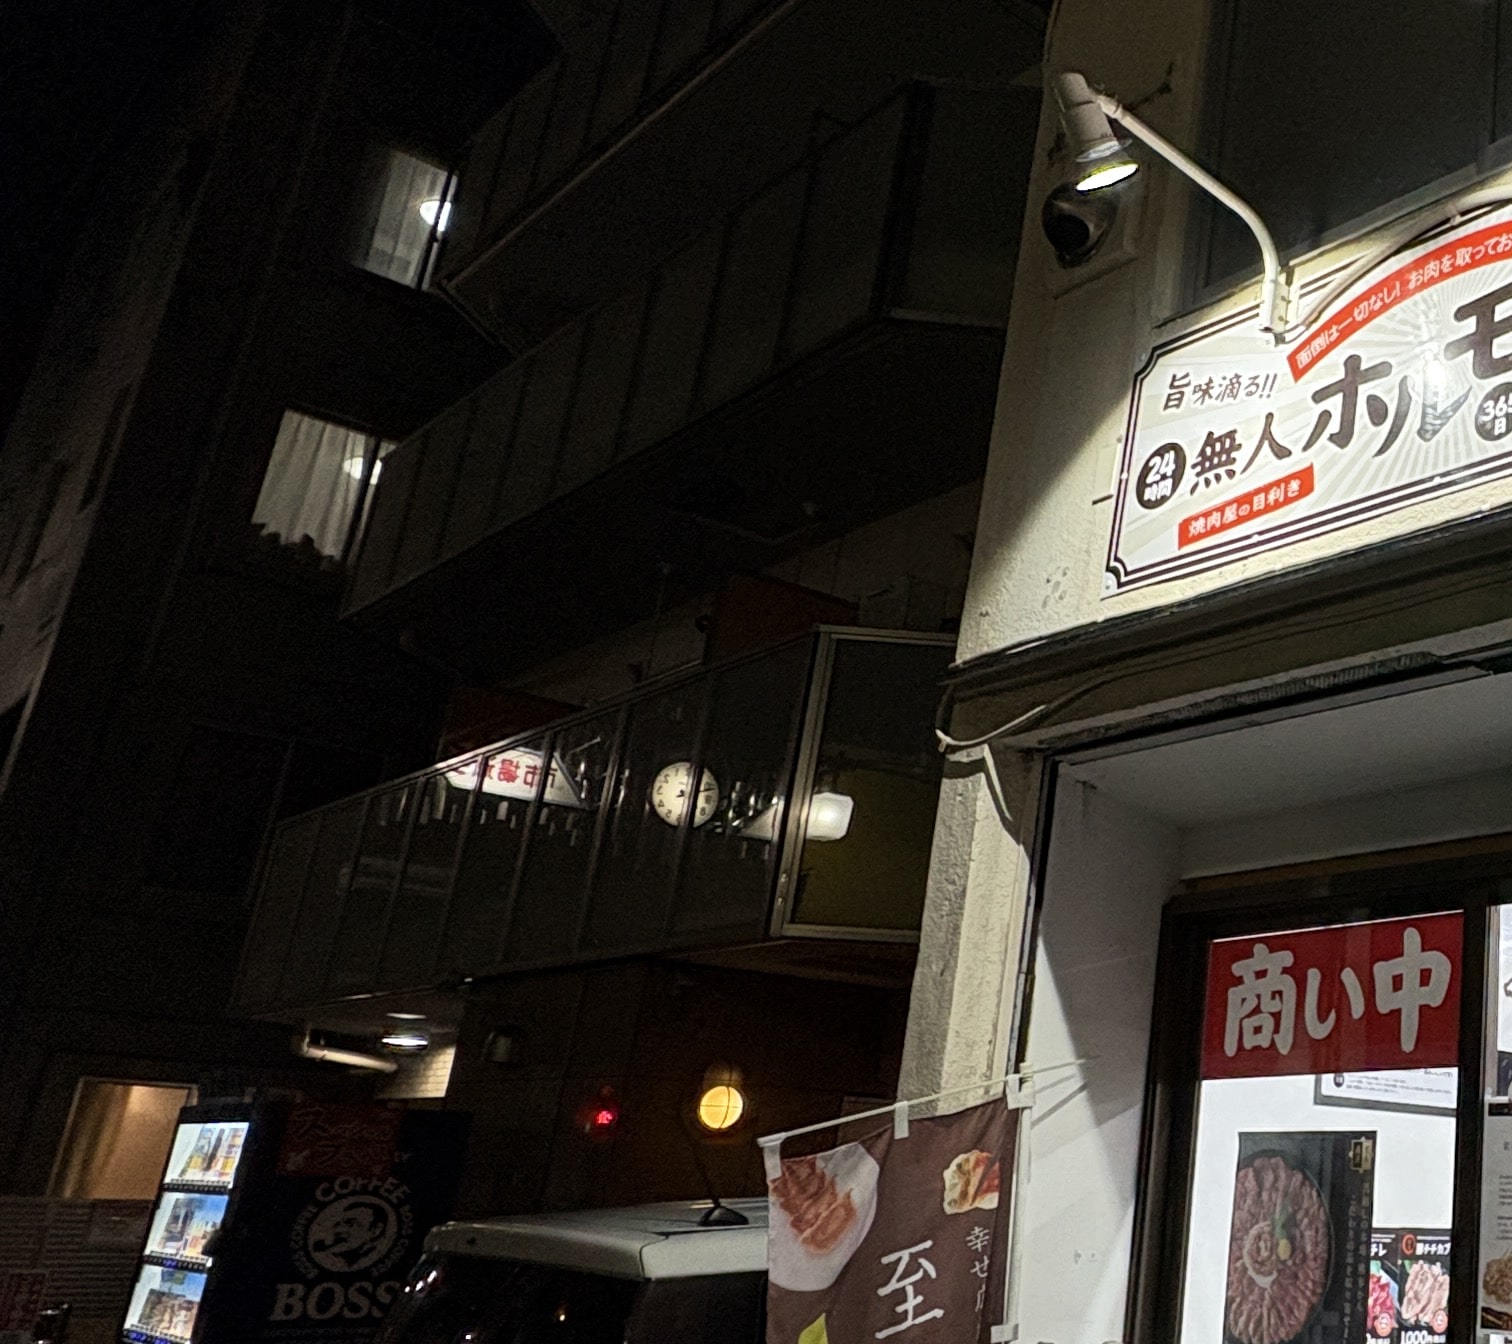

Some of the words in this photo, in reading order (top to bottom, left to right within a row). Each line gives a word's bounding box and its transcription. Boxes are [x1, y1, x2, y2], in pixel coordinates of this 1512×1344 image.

[1163, 372, 1277, 413] 旨味滴る!!
[1187, 478, 1303, 537] 焼肉屋の目利き
[1223, 925, 1452, 1057] 商い中
